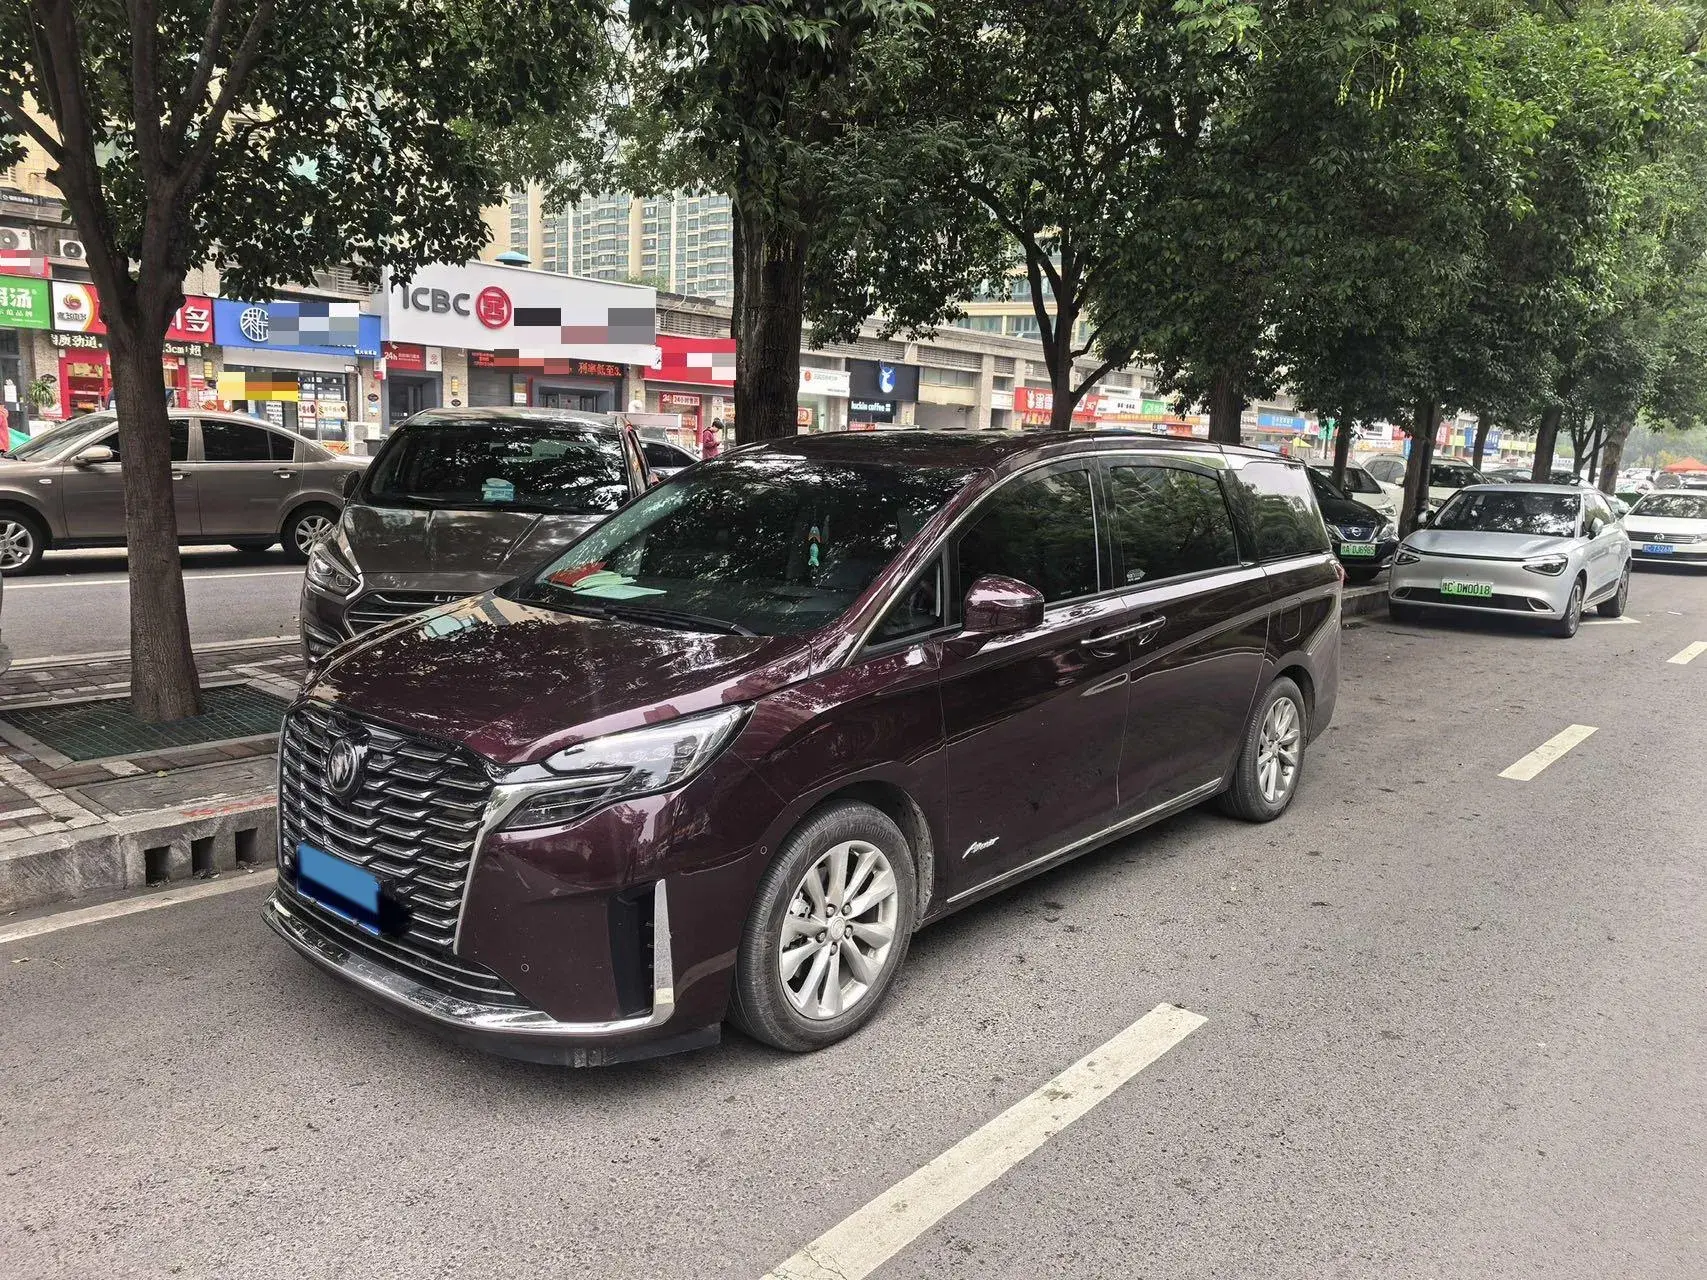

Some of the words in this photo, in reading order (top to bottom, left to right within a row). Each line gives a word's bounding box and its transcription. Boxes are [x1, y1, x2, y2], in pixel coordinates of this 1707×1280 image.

[402, 285, 470, 316] ICBC
[384, 351, 398, 361] 24h
[851, 401, 867, 411] luckin
[868, 402, 885, 411] coffee
